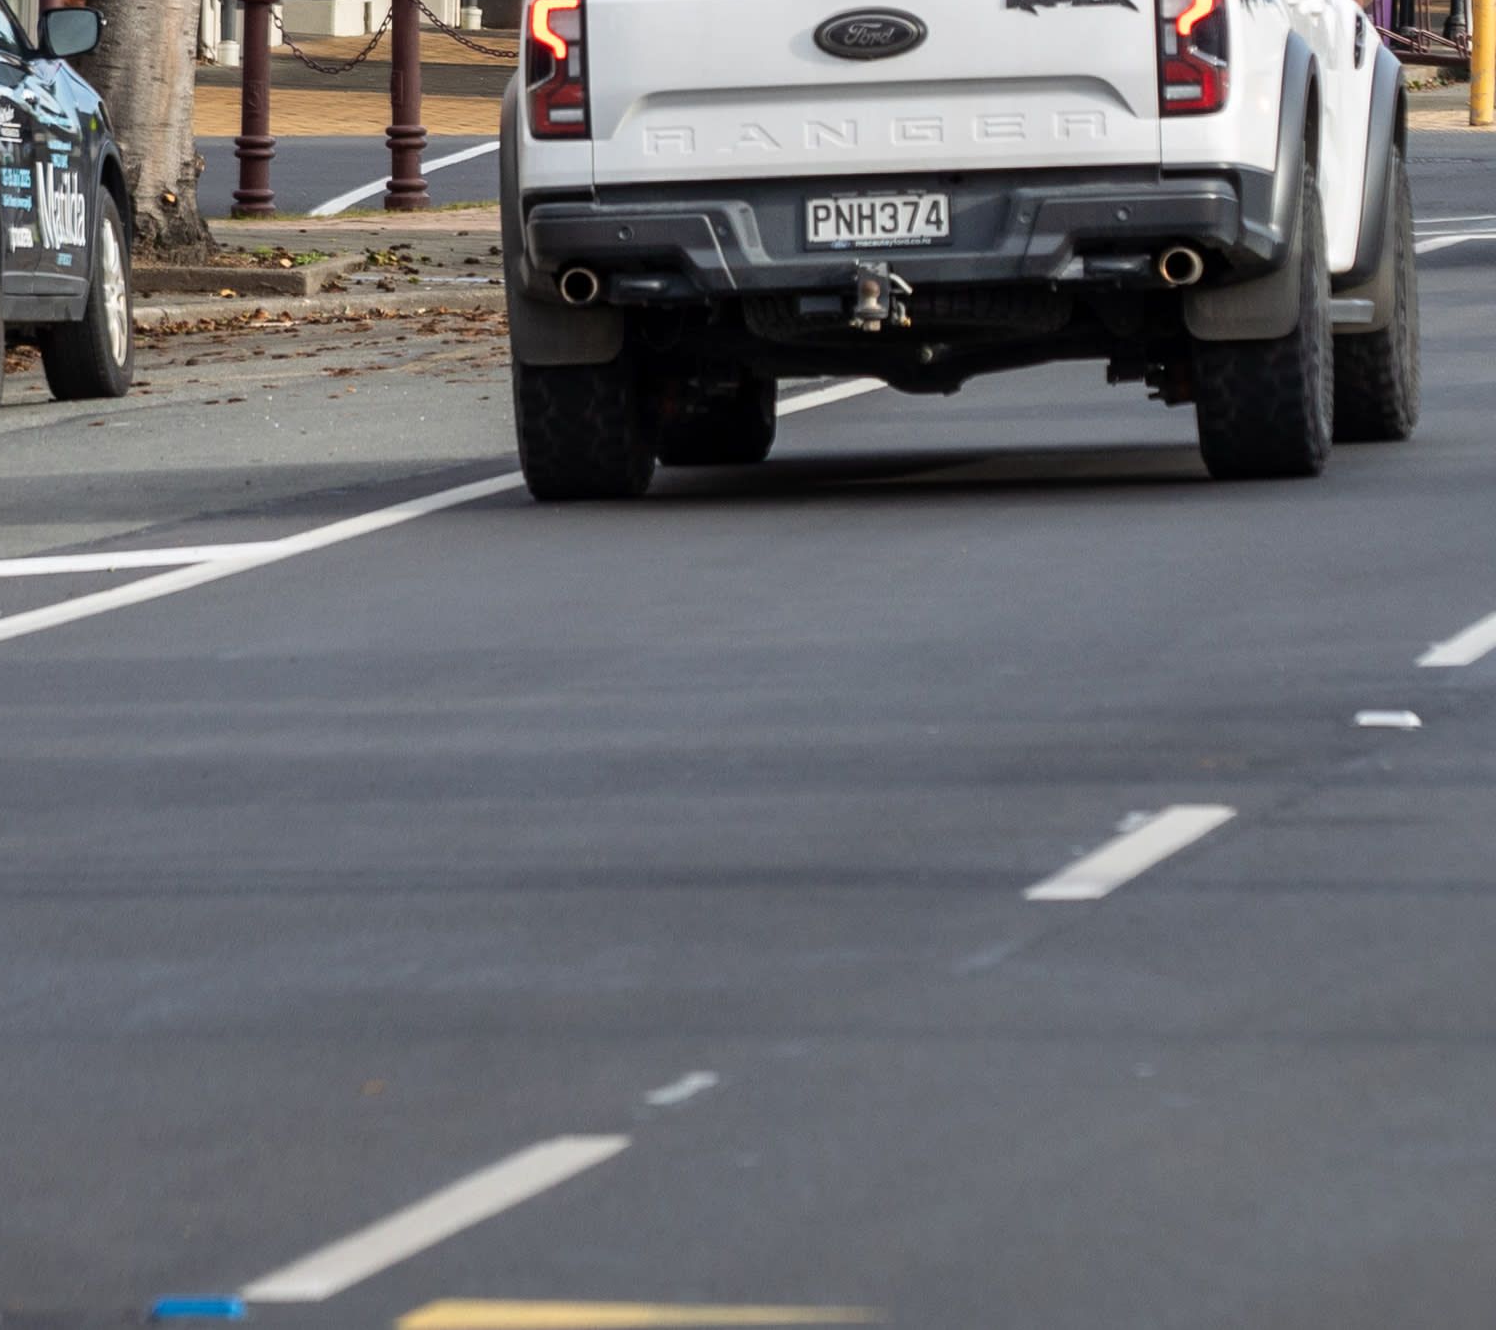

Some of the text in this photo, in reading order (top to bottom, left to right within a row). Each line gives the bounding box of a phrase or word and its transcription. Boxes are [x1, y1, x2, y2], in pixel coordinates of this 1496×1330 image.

[845, 20, 895, 47] Ford
[642, 110, 1107, 156] RANGER
[36, 161, 86, 250] Matilda
[813, 199, 944, 237] PNH374
